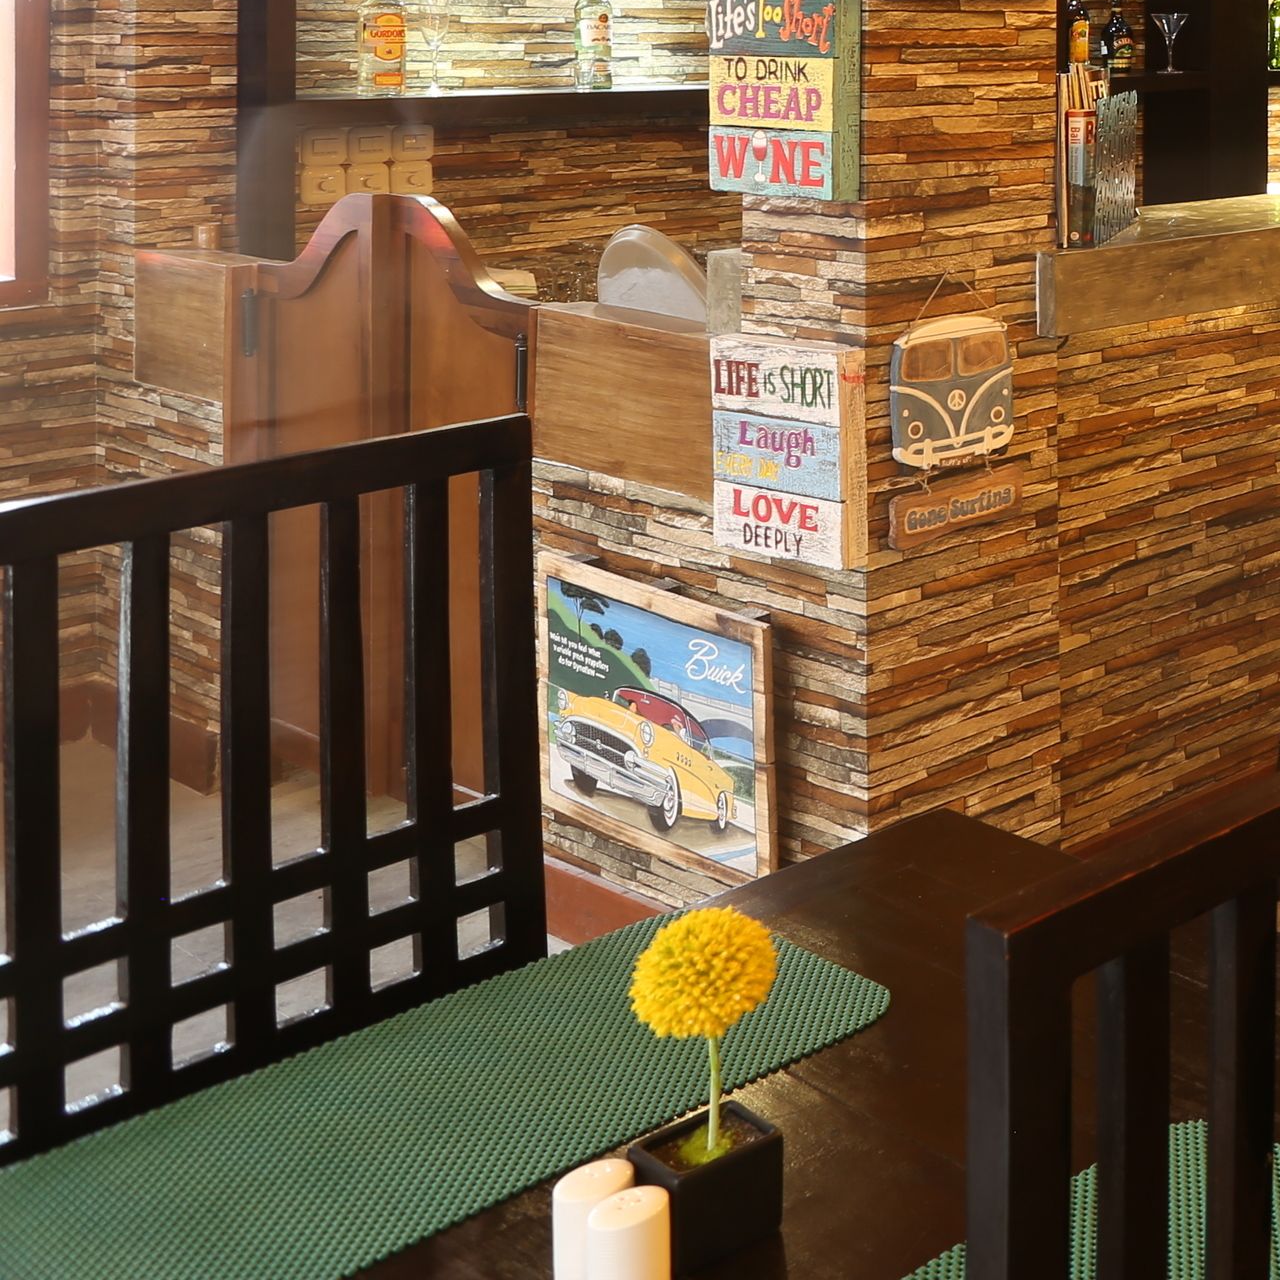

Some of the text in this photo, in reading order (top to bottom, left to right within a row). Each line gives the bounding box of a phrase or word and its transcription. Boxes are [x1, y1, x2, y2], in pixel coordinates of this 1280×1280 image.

[724, 57, 810, 82] TO DRINK
[717, 83, 822, 122] CHEAP
[714, 359, 760, 398] LIFE
[780, 365, 833, 409] SHORT
[738, 420, 816, 469] Laugh
[733, 488, 819, 532] LOVE
[907, 488, 1012, 532] Gone Surfing
[743, 522, 803, 556] DEEPLY
[685, 638, 746, 694] Buick
